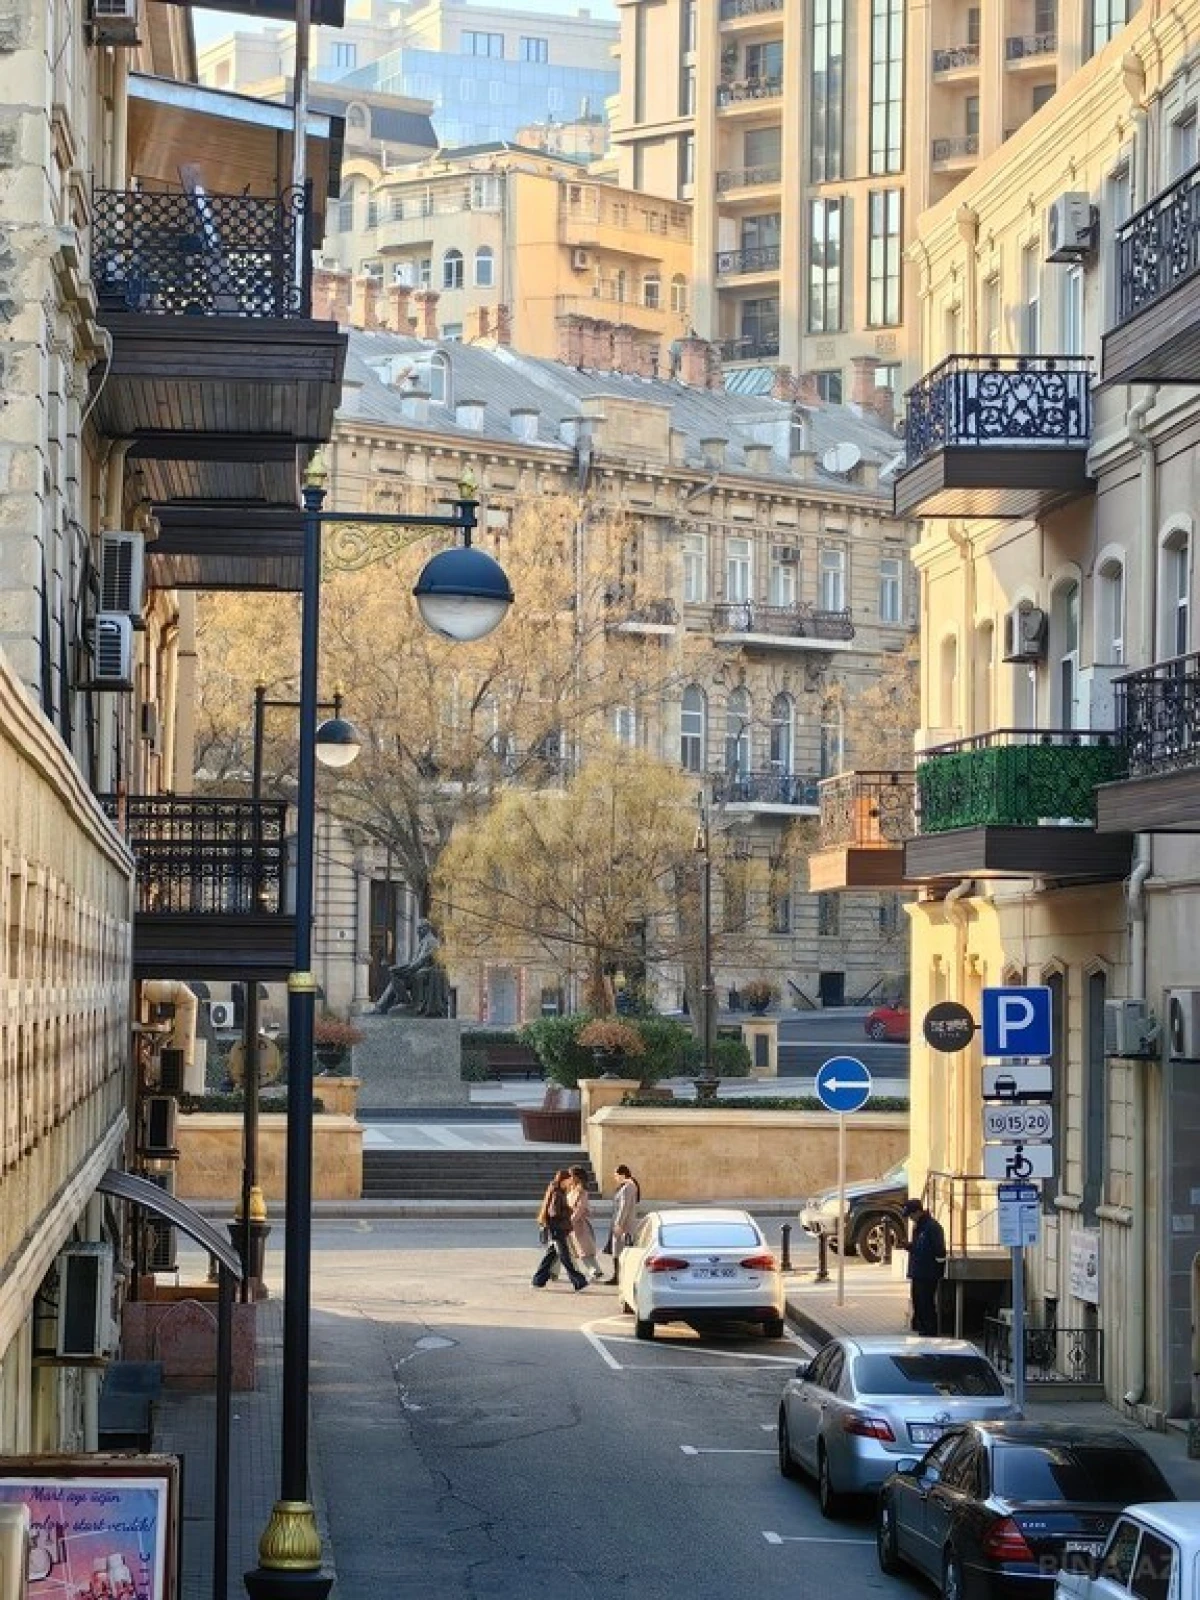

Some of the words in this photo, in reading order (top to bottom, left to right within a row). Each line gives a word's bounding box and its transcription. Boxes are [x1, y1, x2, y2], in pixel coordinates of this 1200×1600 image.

[998, 995, 1035, 1048] P
[990, 1118, 1003, 1128] 10
[1008, 1116, 1022, 1129] 15
[1028, 1116, 1045, 1129] 20
